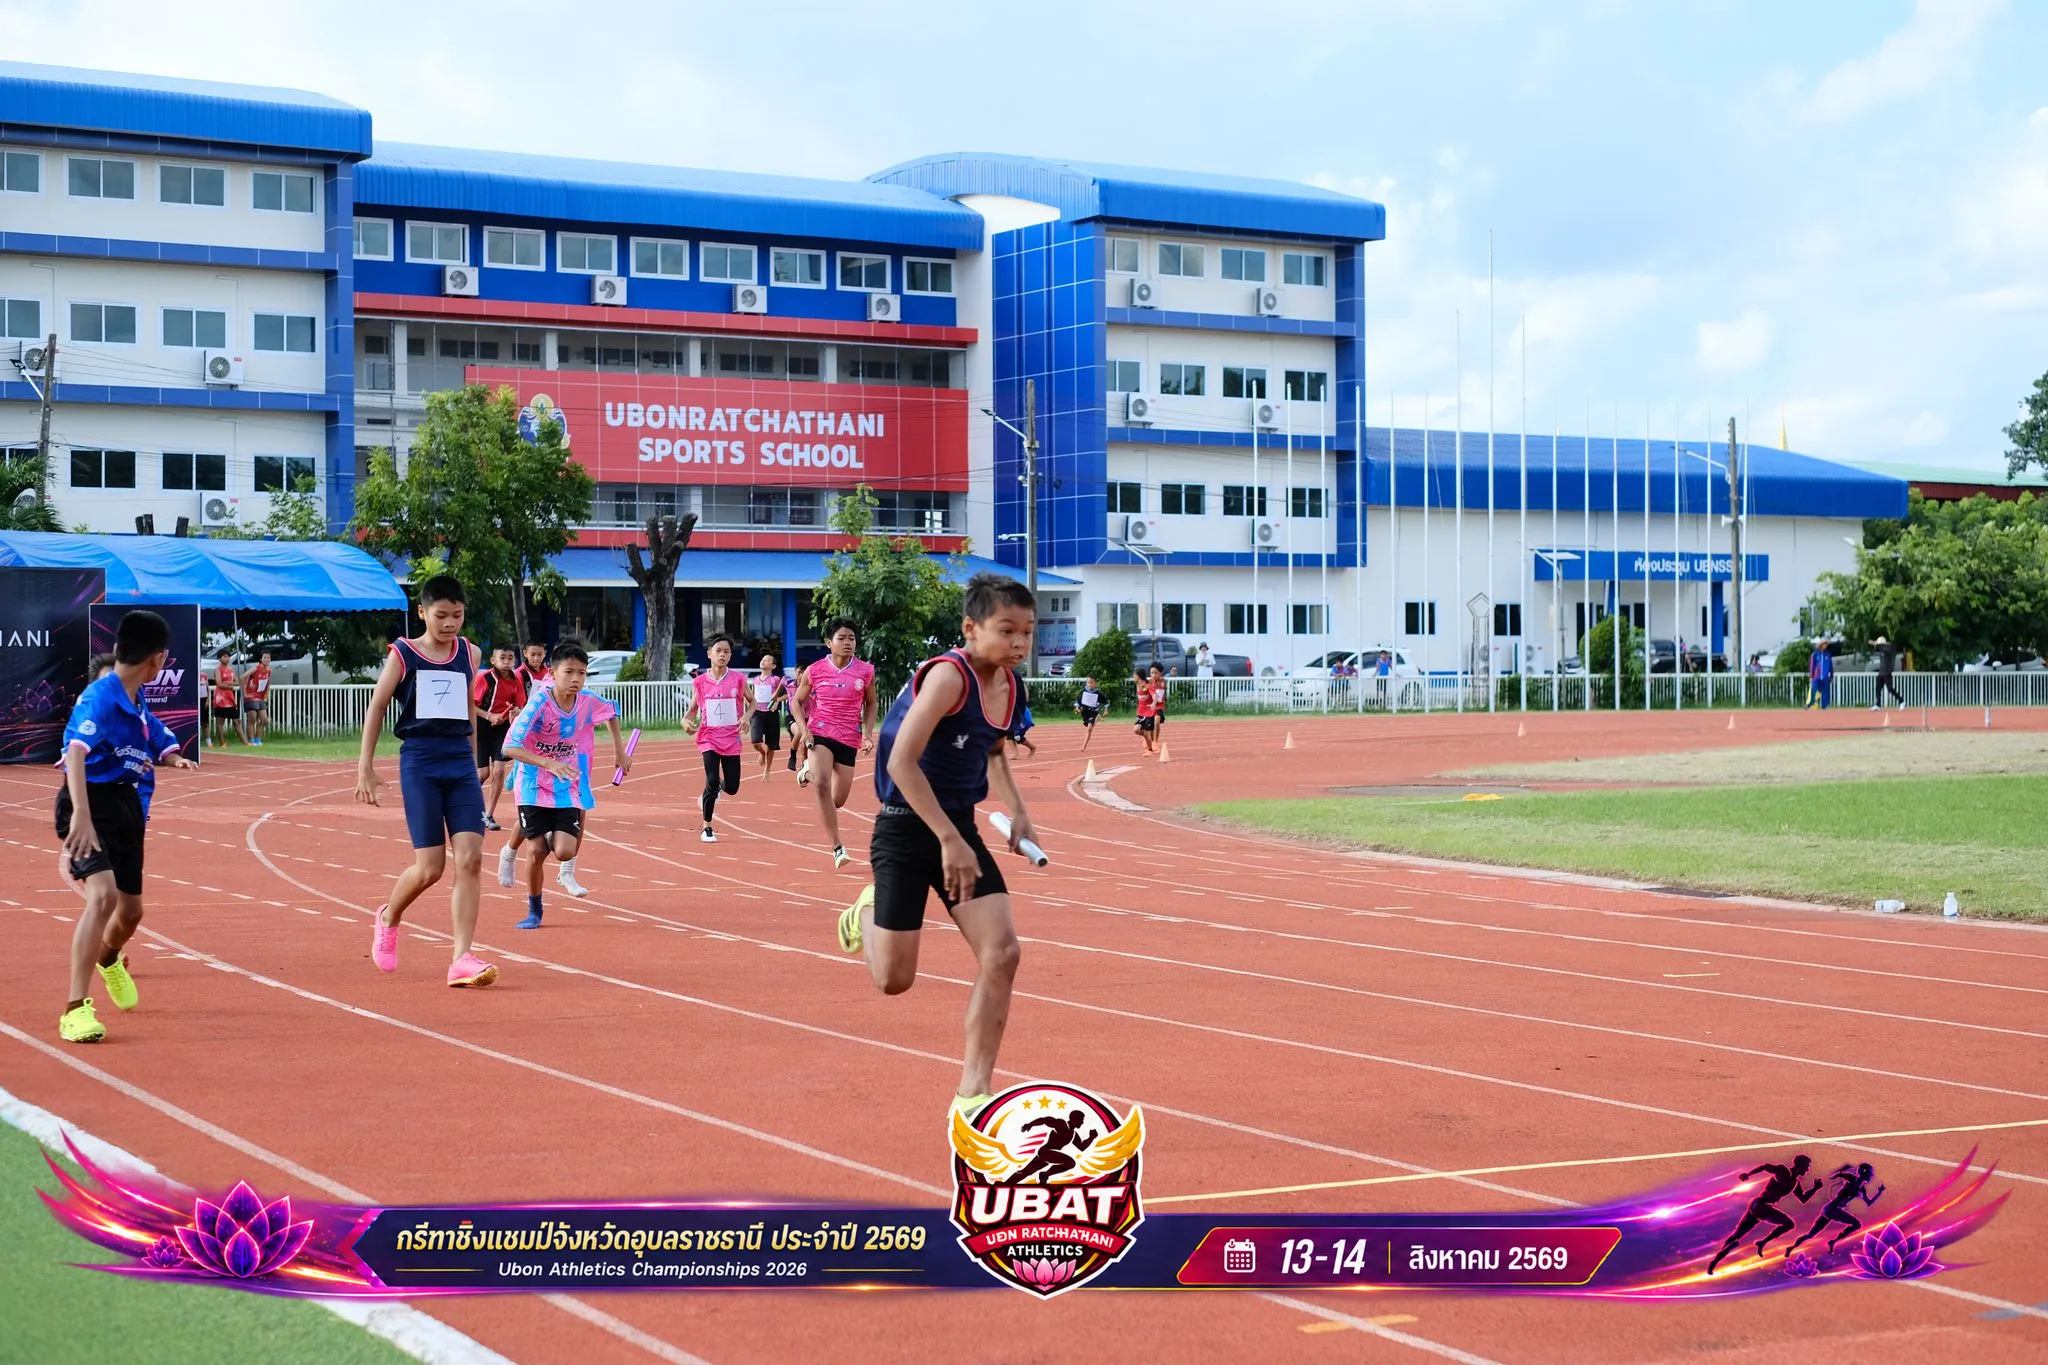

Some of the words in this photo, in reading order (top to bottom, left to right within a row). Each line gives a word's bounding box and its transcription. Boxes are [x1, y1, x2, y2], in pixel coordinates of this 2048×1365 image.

[605, 402, 884, 437] UBONRATCHATHANI
[638, 437, 745, 464] SPORTS
[760, 442, 864, 468] SCHOOL
[143, 686, 181, 695] ETICS
[431, 679, 452, 706] 7
[713, 702, 727, 720] 4
